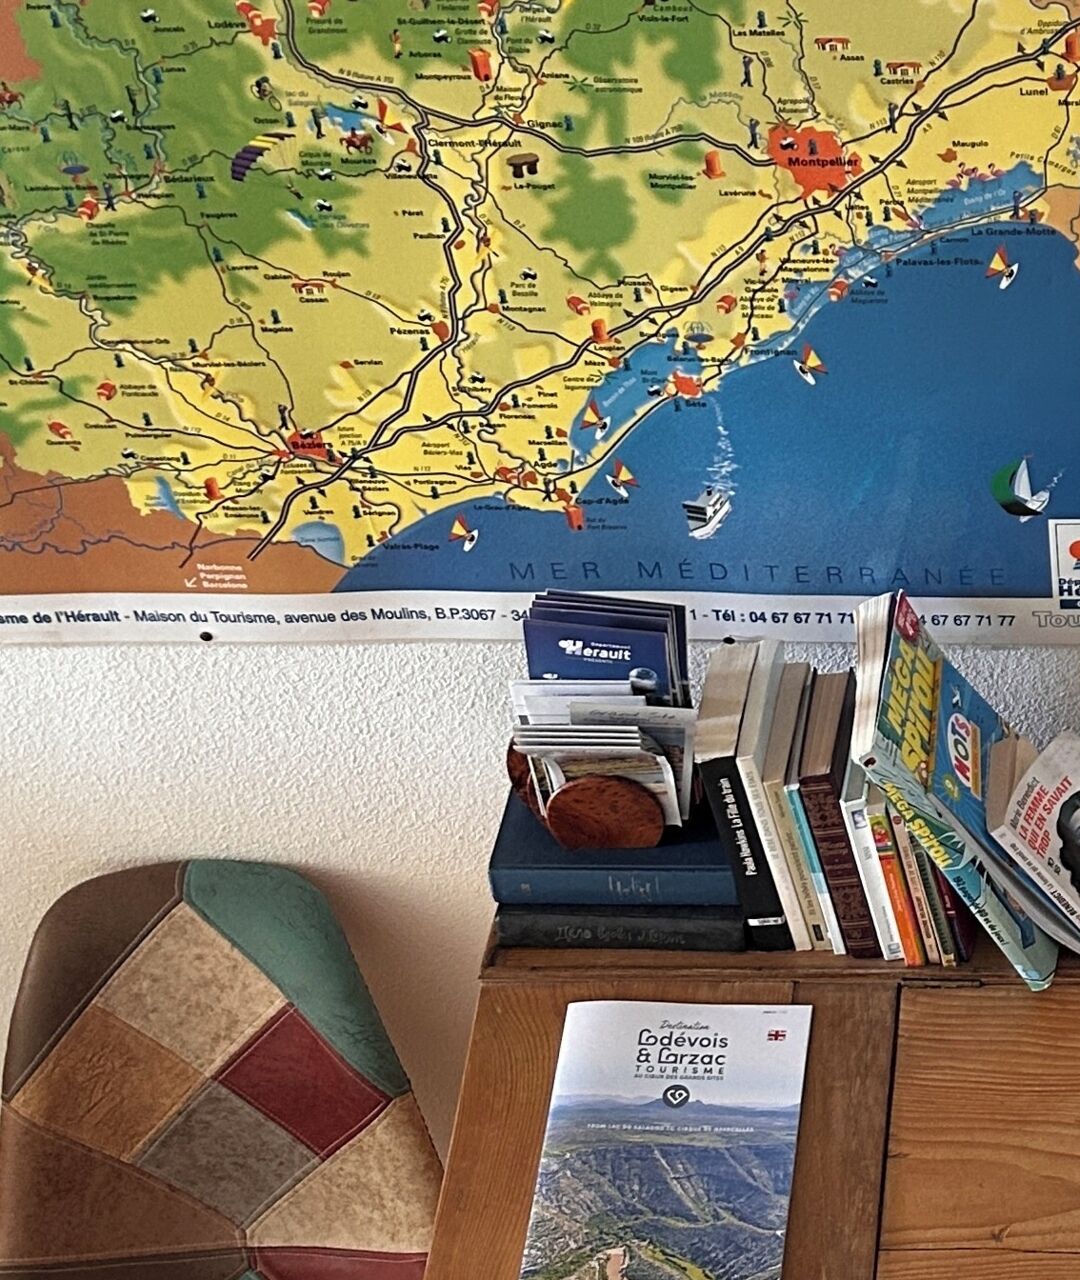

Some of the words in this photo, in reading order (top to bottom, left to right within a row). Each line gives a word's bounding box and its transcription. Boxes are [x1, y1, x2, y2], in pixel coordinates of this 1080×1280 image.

[1019, 87, 1049, 97] Lunel
[526, 119, 563, 131] Gignac
[787, 157, 861, 169] Montpellier
[987, 227, 1058, 238] Grande-Motte
[389, 326, 431, 337] Pézenas
[290, 440, 333, 450] Béziers
[508, 561, 602, 581] MER
[637, 558, 1006, 586] MÉDITERRANÉE
[32, 611, 52, 624] de
[54, 609, 122, 623] l'Hérault
[133, 608, 187, 624] Maison
[188, 609, 209, 623] du
[210, 609, 281, 626] Tourisme,
[284, 611, 337, 624] avenue
[340, 608, 368, 623] des
[371, 607, 432, 623] Moulins,
[434, 606, 497, 622] B.P.3067
[711, 608, 737, 623] Tél
[749, 610, 768, 624] 04
[771, 611, 789, 624] 67
[793, 611, 812, 624] 67
[815, 612, 834, 625] 71
[838, 612, 855, 625] 71
[931, 614, 949, 626] 67
[953, 614, 972, 627] 67
[976, 614, 993, 627] 71
[999, 614, 1016, 627] 77
[953, 715, 971, 783] MOTS
[717, 777, 732, 795] train
[1016, 776, 1041, 810] Benedict
[723, 795, 736, 804] du
[726, 803, 740, 819] Fille
[1018, 825, 1031, 841] LA
[1026, 784, 1051, 827] FEMME
[1027, 828, 1041, 851] QUI
[1037, 815, 1048, 831] EN
[1045, 775, 1074, 814] SAVAIT
[730, 819, 744, 829] La
[735, 828, 753, 857] Hawkins
[1036, 829, 1052, 860] TROP
[742, 856, 758, 876] Paula
[1050, 889, 1079, 917] BENEDICT
[637, 1028, 729, 1049] Lodévois
[636, 1047, 651, 1064] &
[657, 1047, 727, 1066] Larzac
[635, 1064, 725, 1075] TOURISME
